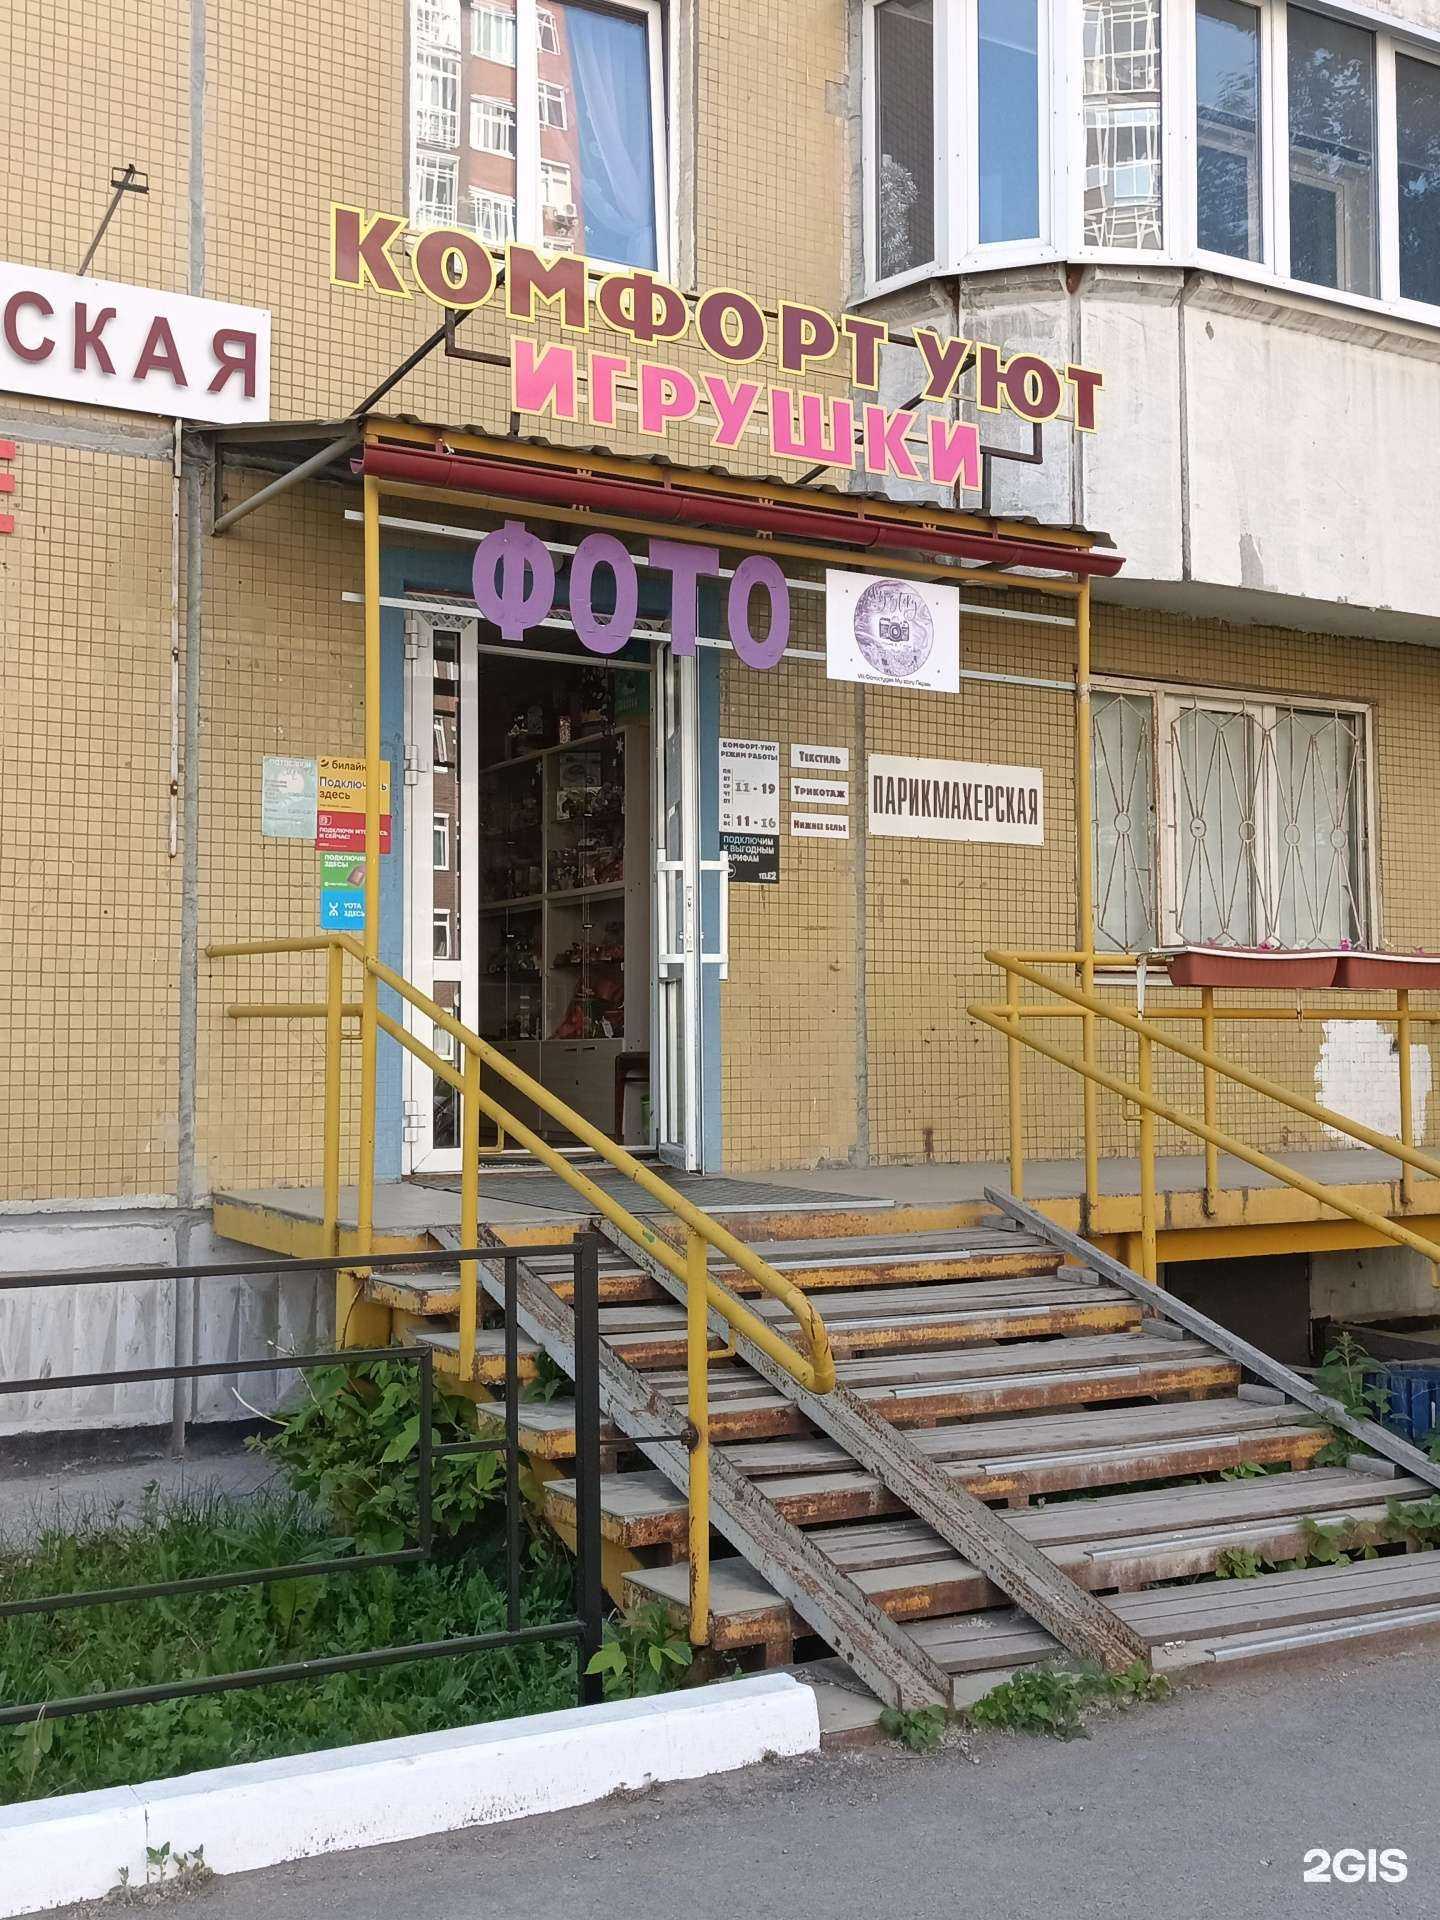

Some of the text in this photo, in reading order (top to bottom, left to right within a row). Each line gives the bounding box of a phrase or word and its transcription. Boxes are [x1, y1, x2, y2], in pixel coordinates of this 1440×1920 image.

[330, 201, 1103, 433] КОМФОРТ УЮТ
[3, 290, 257, 399] СКАЯ
[511, 335, 983, 492] ИГРУШКИ
[472, 520, 790, 670] ФОТО
[720, 751, 778, 761] РЕЖИМ РАБОТЫ
[332, 760, 367, 772] билайн
[319, 777, 387, 791] Подключь
[735, 782, 750, 793] 11
[761, 783, 776, 795] 19
[319, 791, 350, 800] здесь
[873, 775, 1038, 826] ПАРИКМАХЕРСКАЯ
[736, 814, 750, 827] 11
[761, 817, 776, 829] 16
[723, 835, 774, 846] ПОДКЛЮЧИМ
[730, 845, 775, 855] ВЫГОДНЫМ
[727, 853, 760, 863] АРИФАМ
